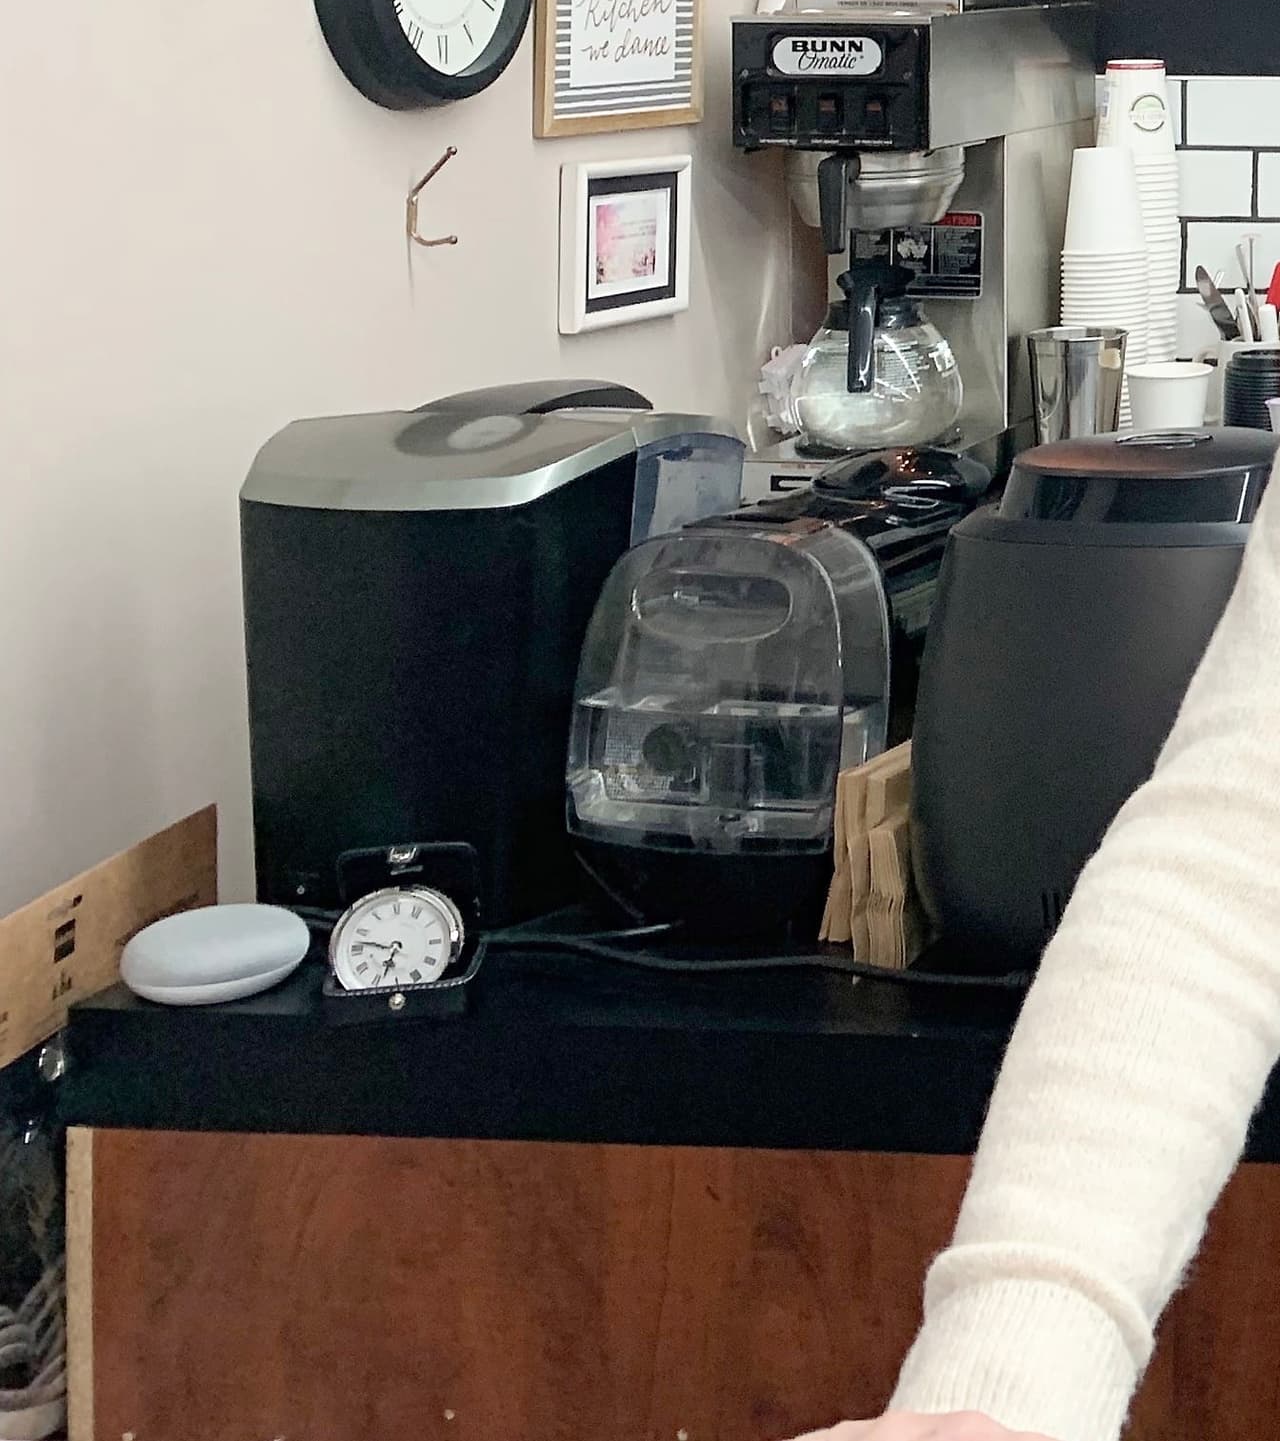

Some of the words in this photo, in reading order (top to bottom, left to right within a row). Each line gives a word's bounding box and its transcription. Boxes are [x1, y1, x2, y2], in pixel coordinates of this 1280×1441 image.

[581, 40, 609, 61] we
[615, 28, 670, 62] dance
[791, 40, 864, 53] BUNN
